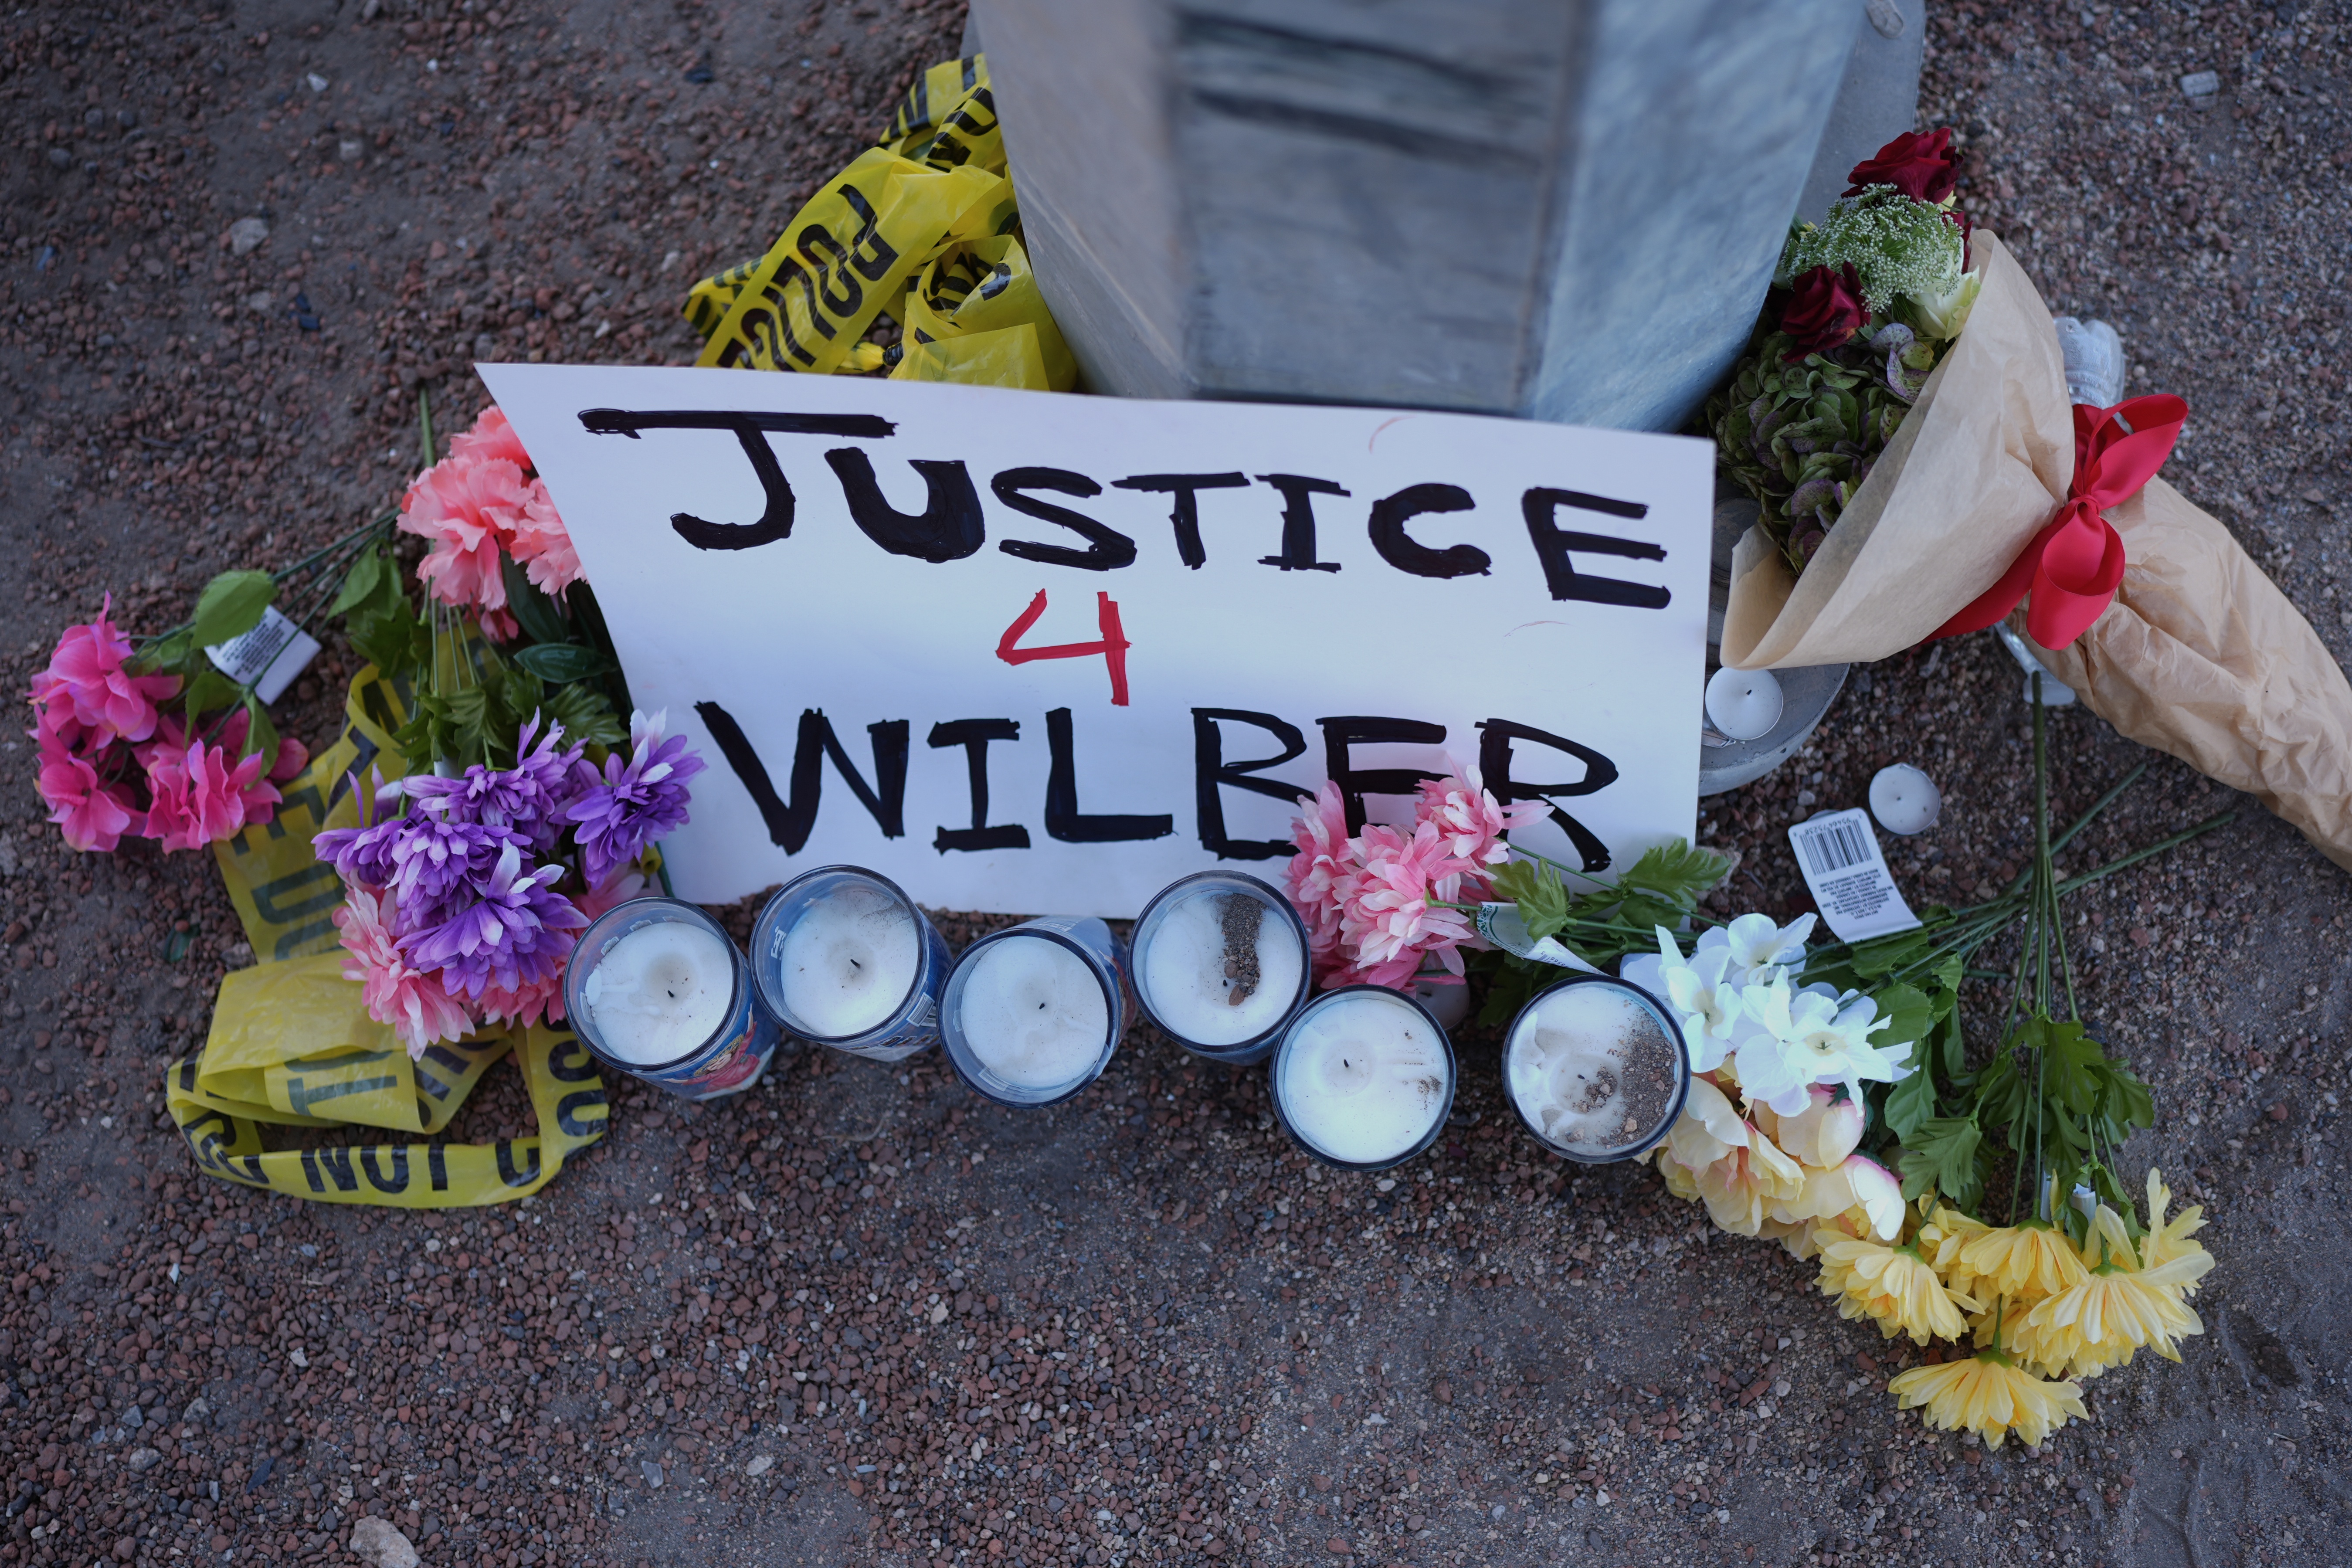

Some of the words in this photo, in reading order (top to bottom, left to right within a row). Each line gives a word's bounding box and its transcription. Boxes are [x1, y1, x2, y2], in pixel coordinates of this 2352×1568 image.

[577, 409, 1672, 610] JUSTICE
[997, 589, 1130, 706] 4
[694, 701, 1619, 873] WILBER
